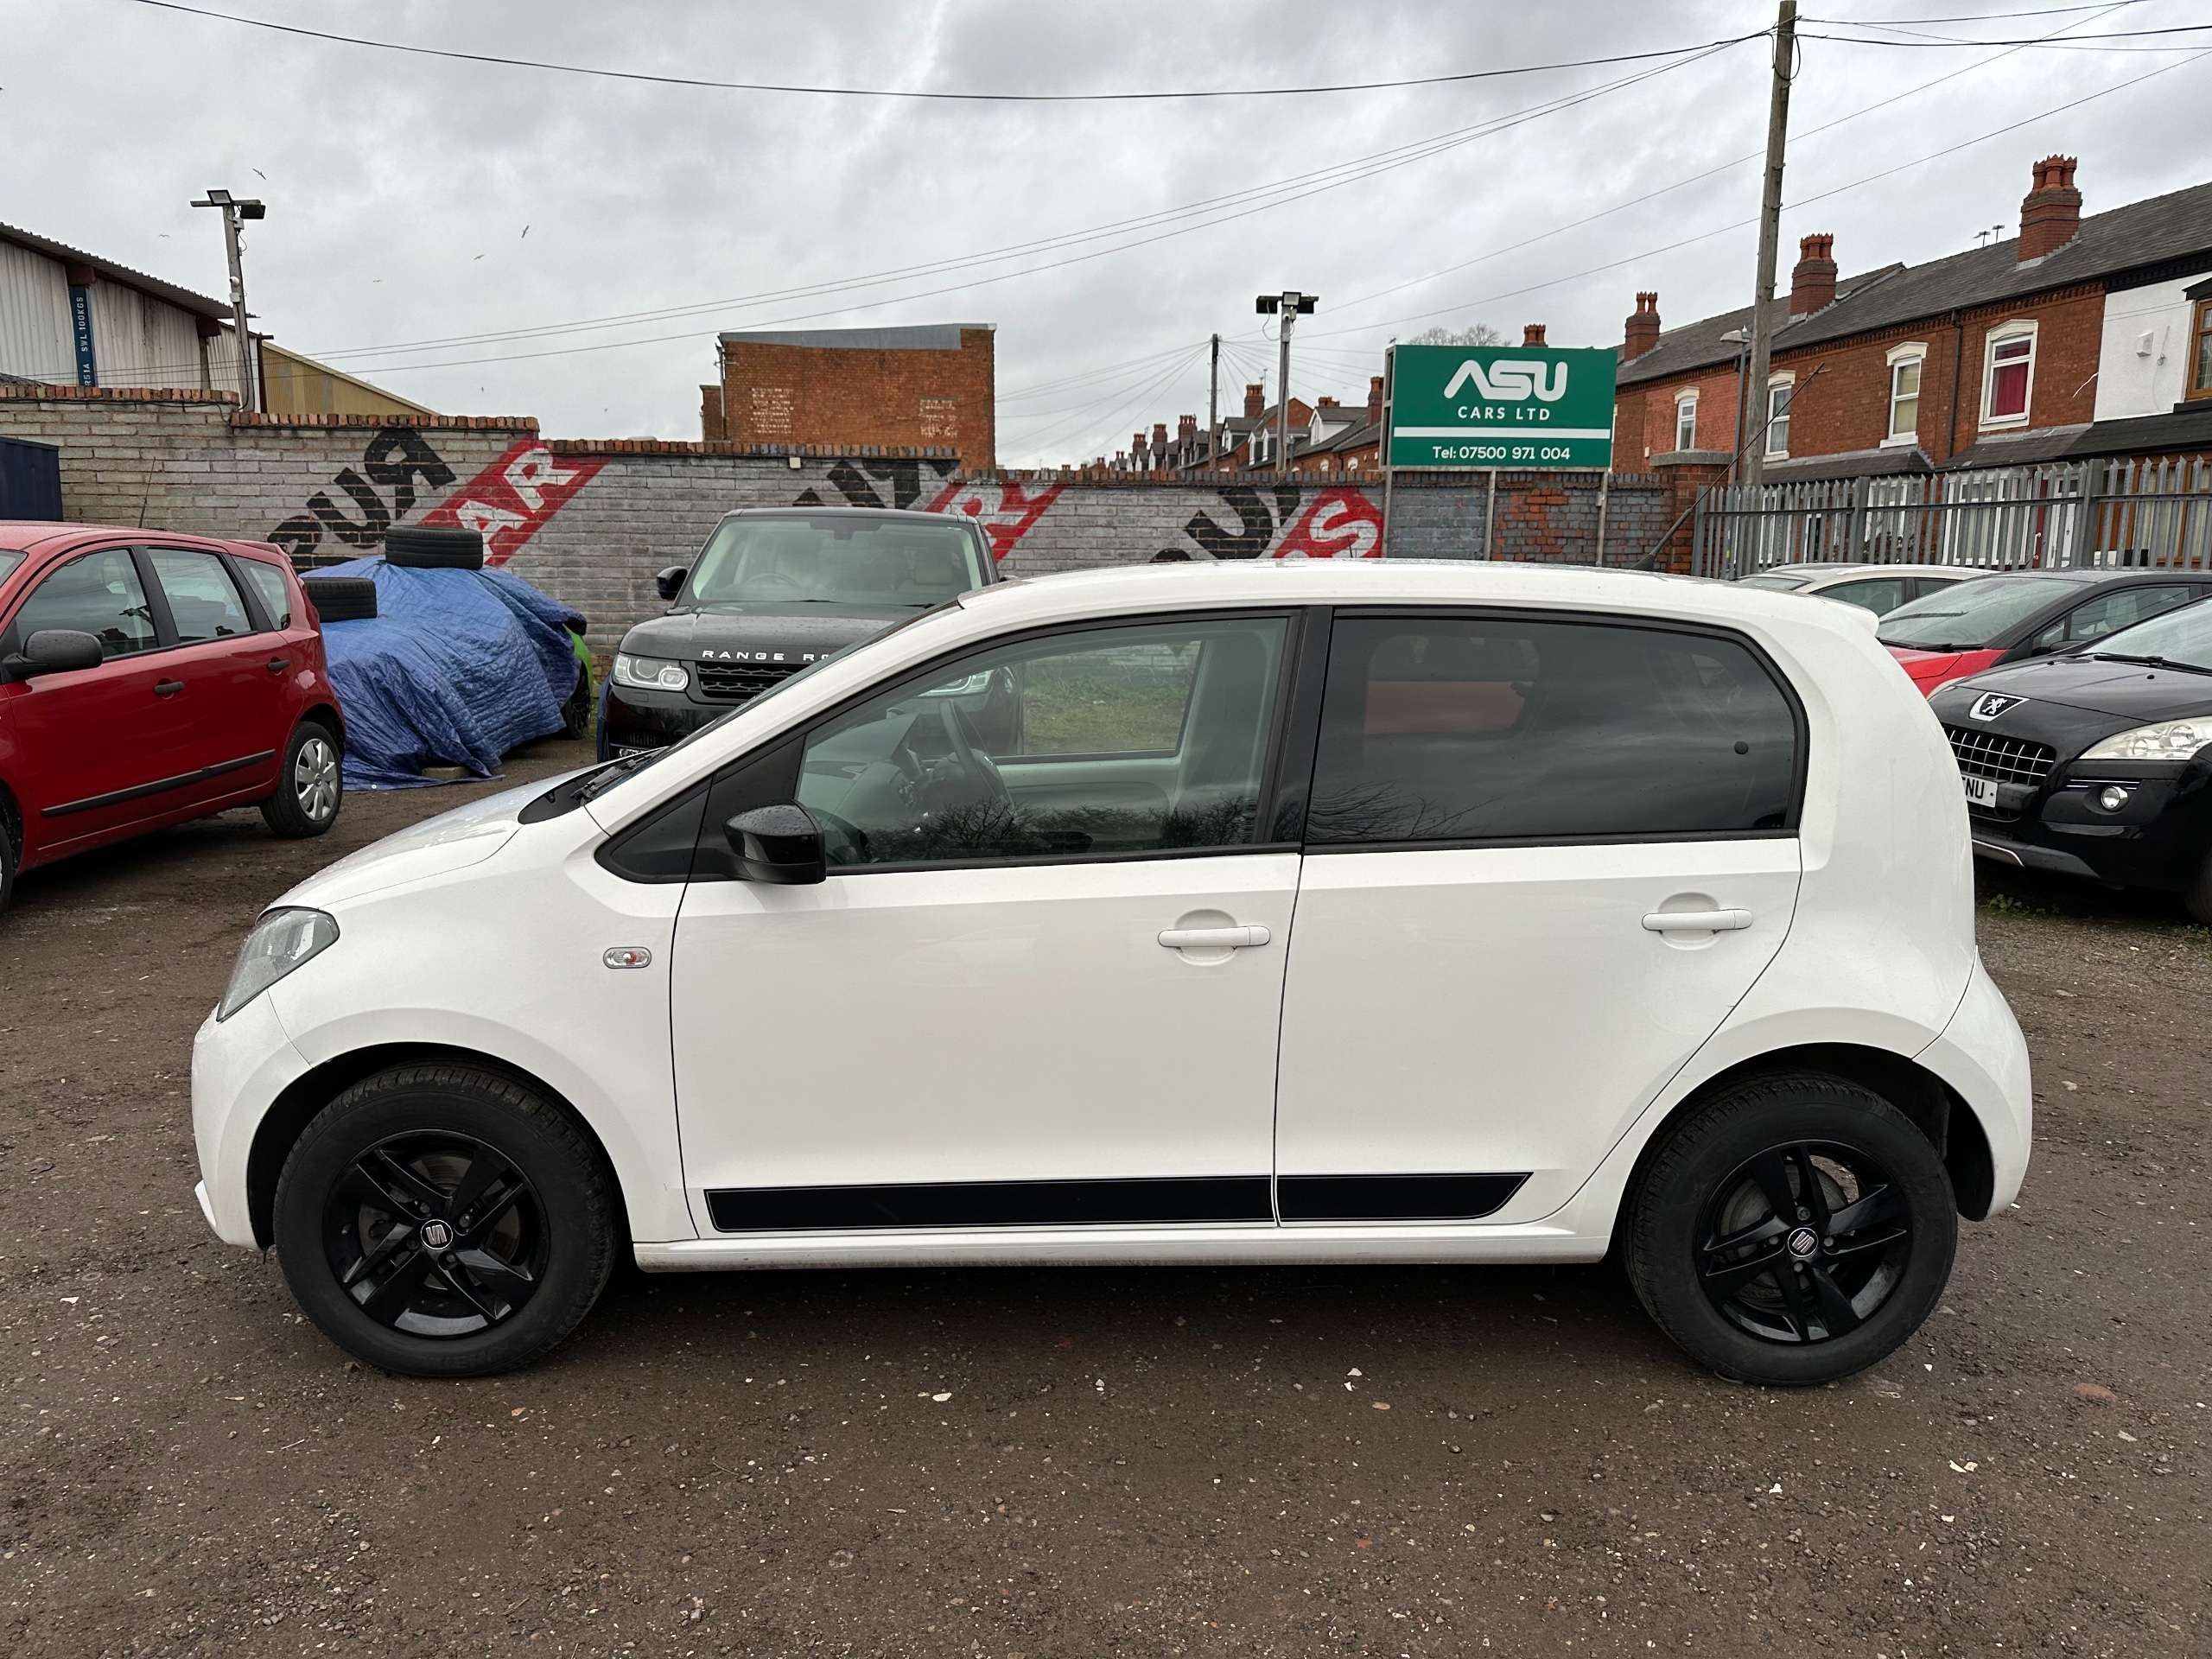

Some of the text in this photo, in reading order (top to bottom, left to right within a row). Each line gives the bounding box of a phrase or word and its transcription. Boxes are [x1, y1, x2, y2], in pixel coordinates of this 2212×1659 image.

[79, 334, 88, 352] SWL
[1444, 359, 1568, 402] ASU
[1458, 406, 1550, 421] CARS LTD
[1433, 447, 1570, 460] Tel: 07500 971 004
[702, 650, 785, 661] RANGE
[1962, 778, 1985, 799] NU
